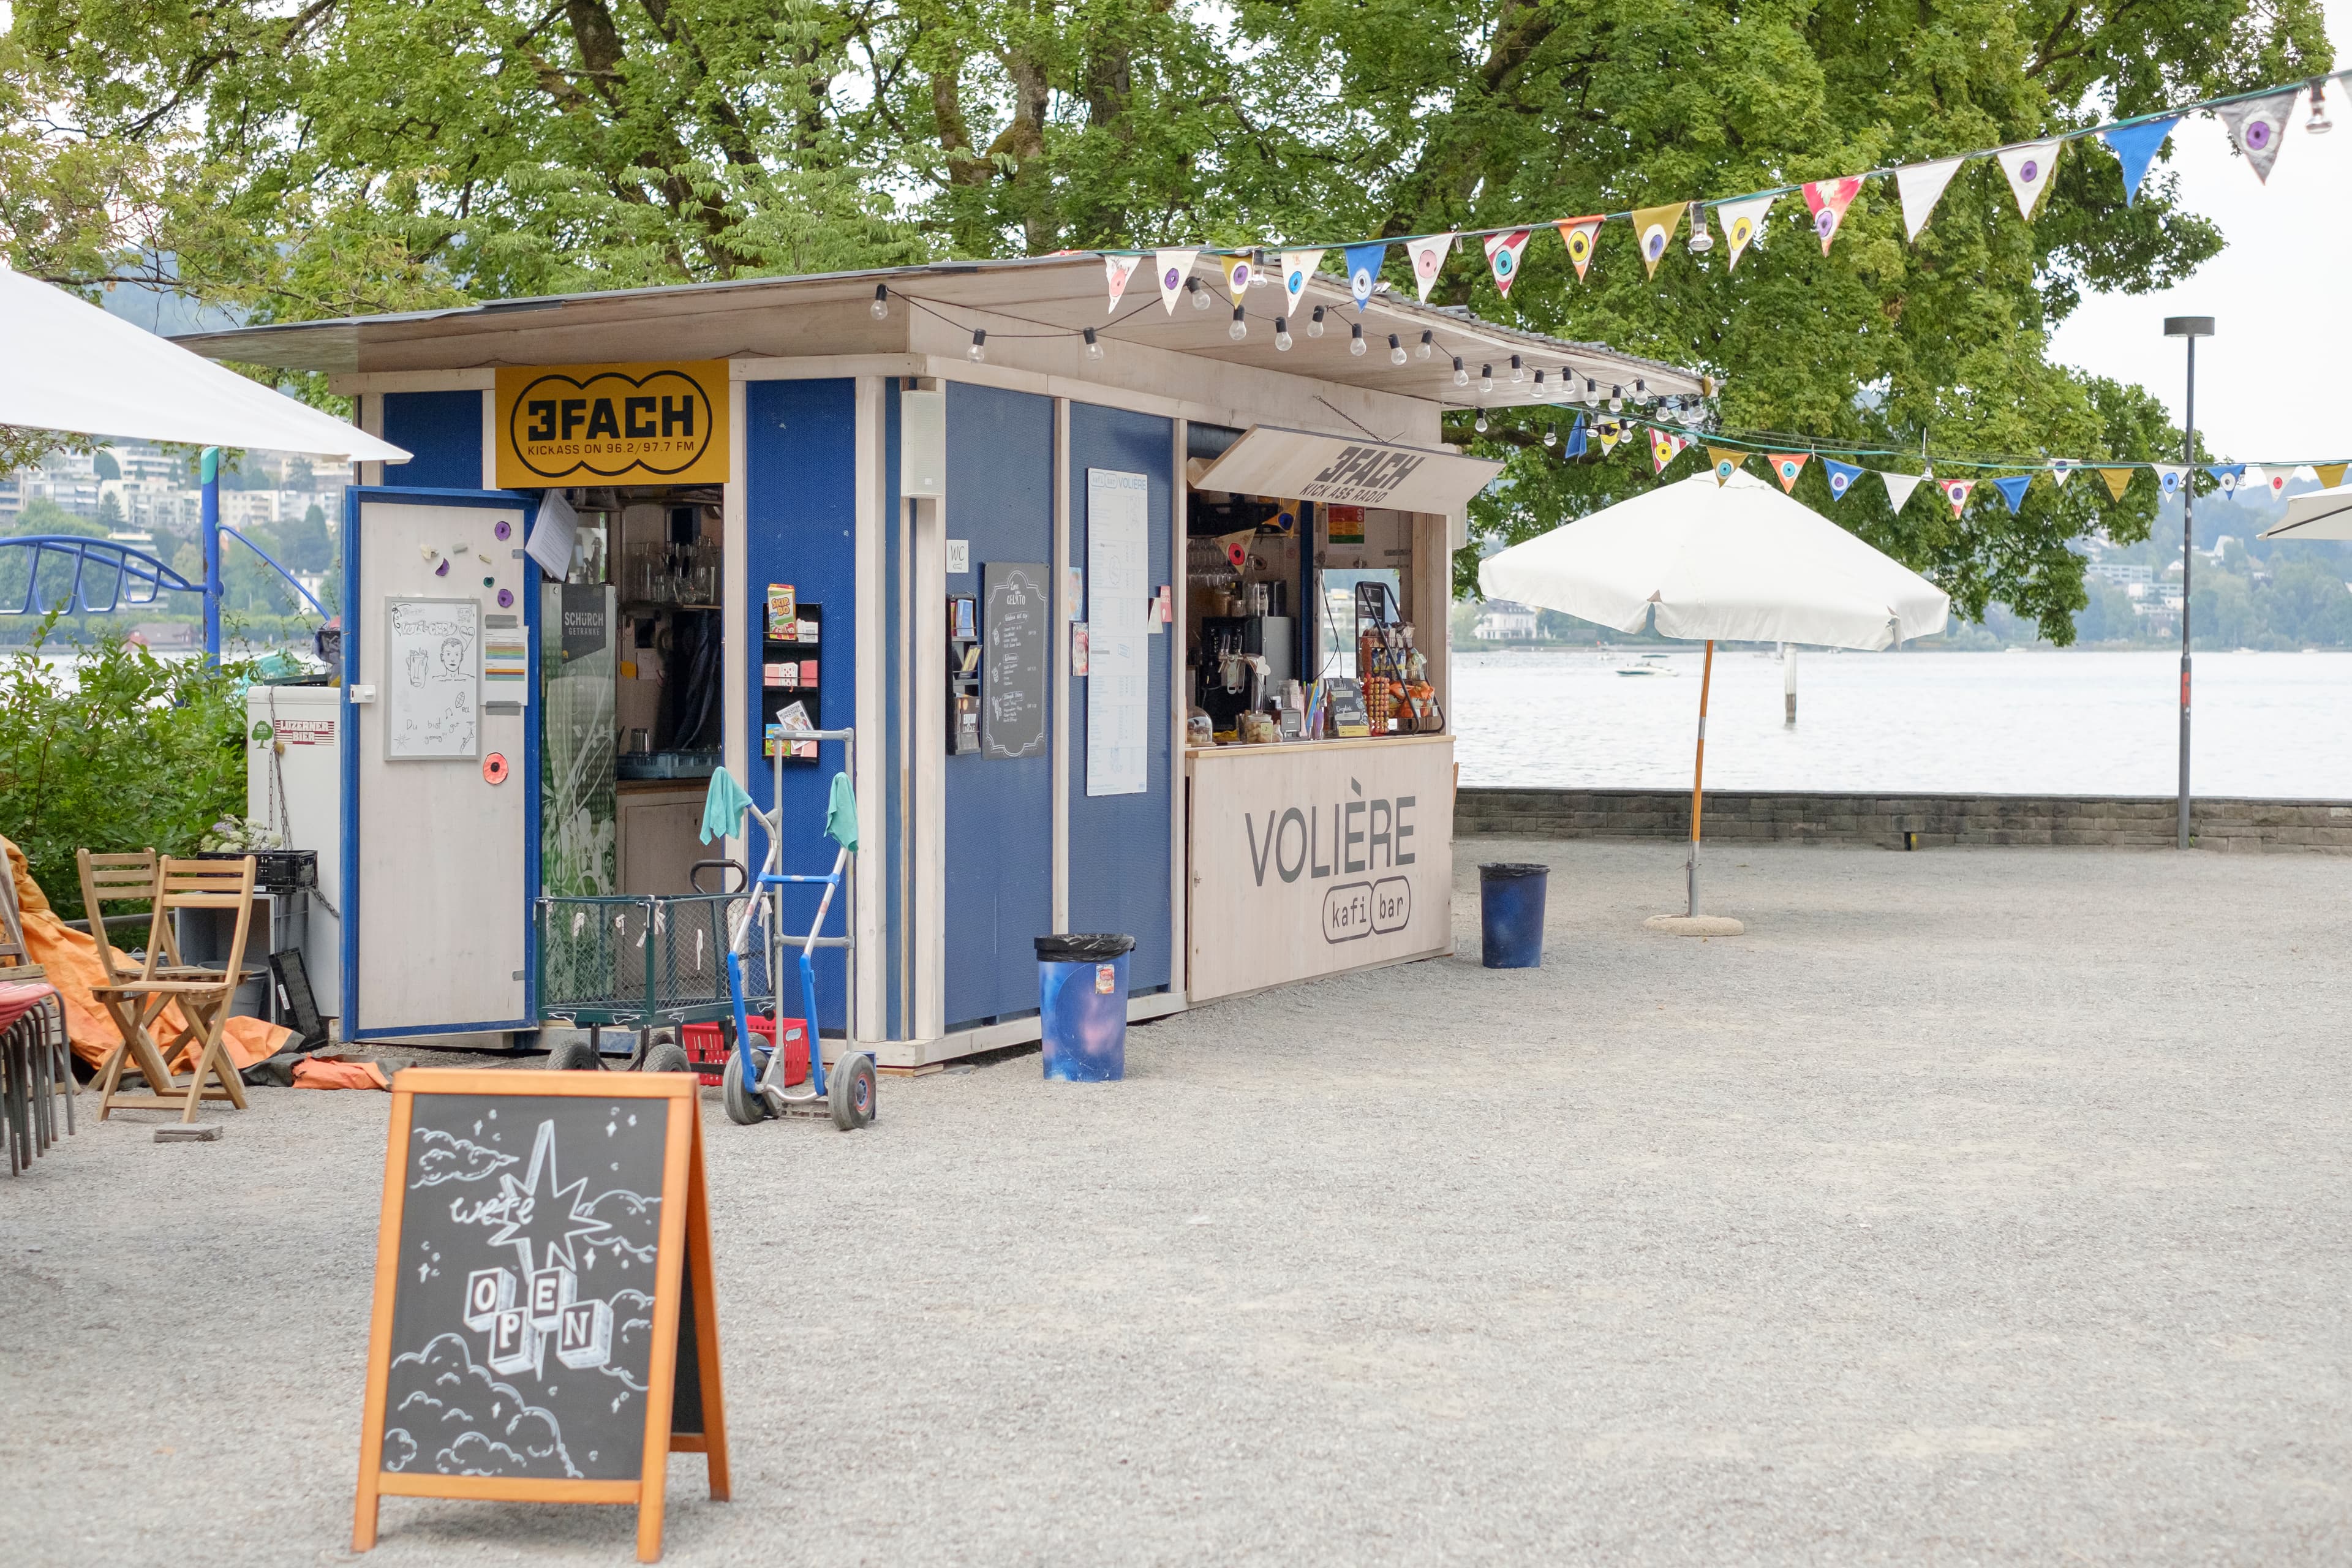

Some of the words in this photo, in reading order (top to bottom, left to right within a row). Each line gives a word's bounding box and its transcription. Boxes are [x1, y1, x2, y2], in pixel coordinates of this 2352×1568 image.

[528, 395, 694, 442] 3FACH
[528, 444, 580, 456] KICKASS
[584, 443, 602, 454] ON
[607, 441, 671, 455] 96.2/97.7
[677, 440, 695, 452] FM
[1314, 446, 1426, 490] 3FACH
[1118, 475, 1147, 490] VOLIÈRE
[1299, 483, 1332, 497] KICK
[1328, 488, 1352, 500] ASS
[1352, 489, 1389, 503] RADIO
[951, 545, 965, 561] WC
[1006, 594, 1026, 606] GELATO
[777, 609, 790, 619] BO
[280, 720, 329, 732] LUZERNER
[406, 719, 418, 730] Du
[292, 731, 315, 742] BIER
[1245, 775, 1416, 887] VOLIÈRE
[1332, 896, 1367, 929] kafi
[1379, 892, 1404, 921] bar
